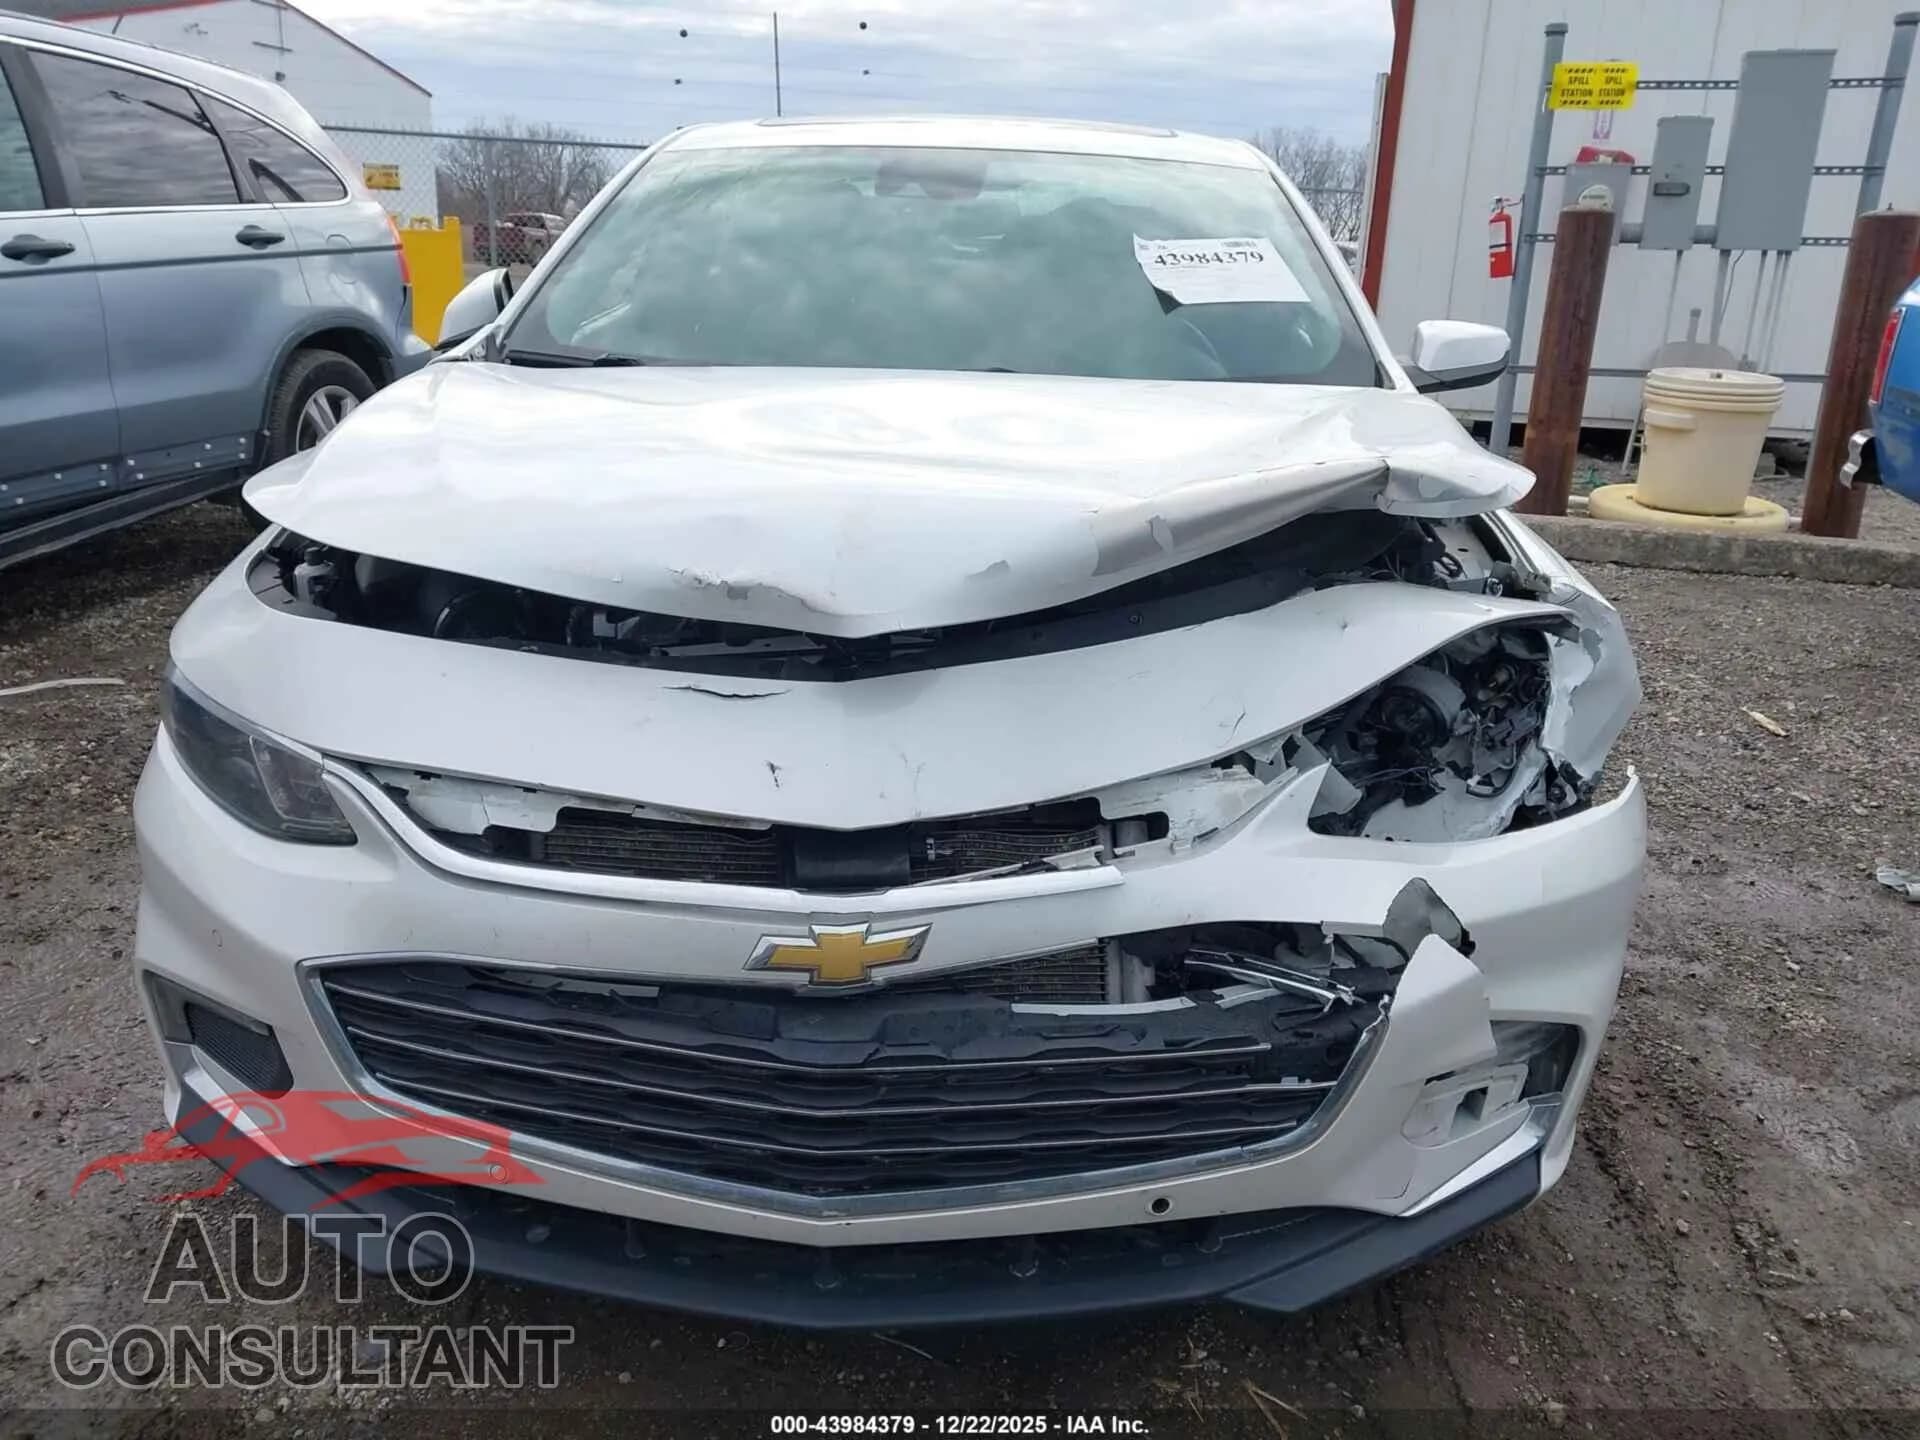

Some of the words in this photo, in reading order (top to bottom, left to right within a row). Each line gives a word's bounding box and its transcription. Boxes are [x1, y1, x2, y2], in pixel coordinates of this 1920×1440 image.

[1567, 76, 1590, 85] SPILL
[1604, 76, 1623, 85] SPILL
[1561, 88, 1593, 97] STATION
[1599, 88, 1626, 97] STATION
[1154, 251, 1264, 266] 43984379
